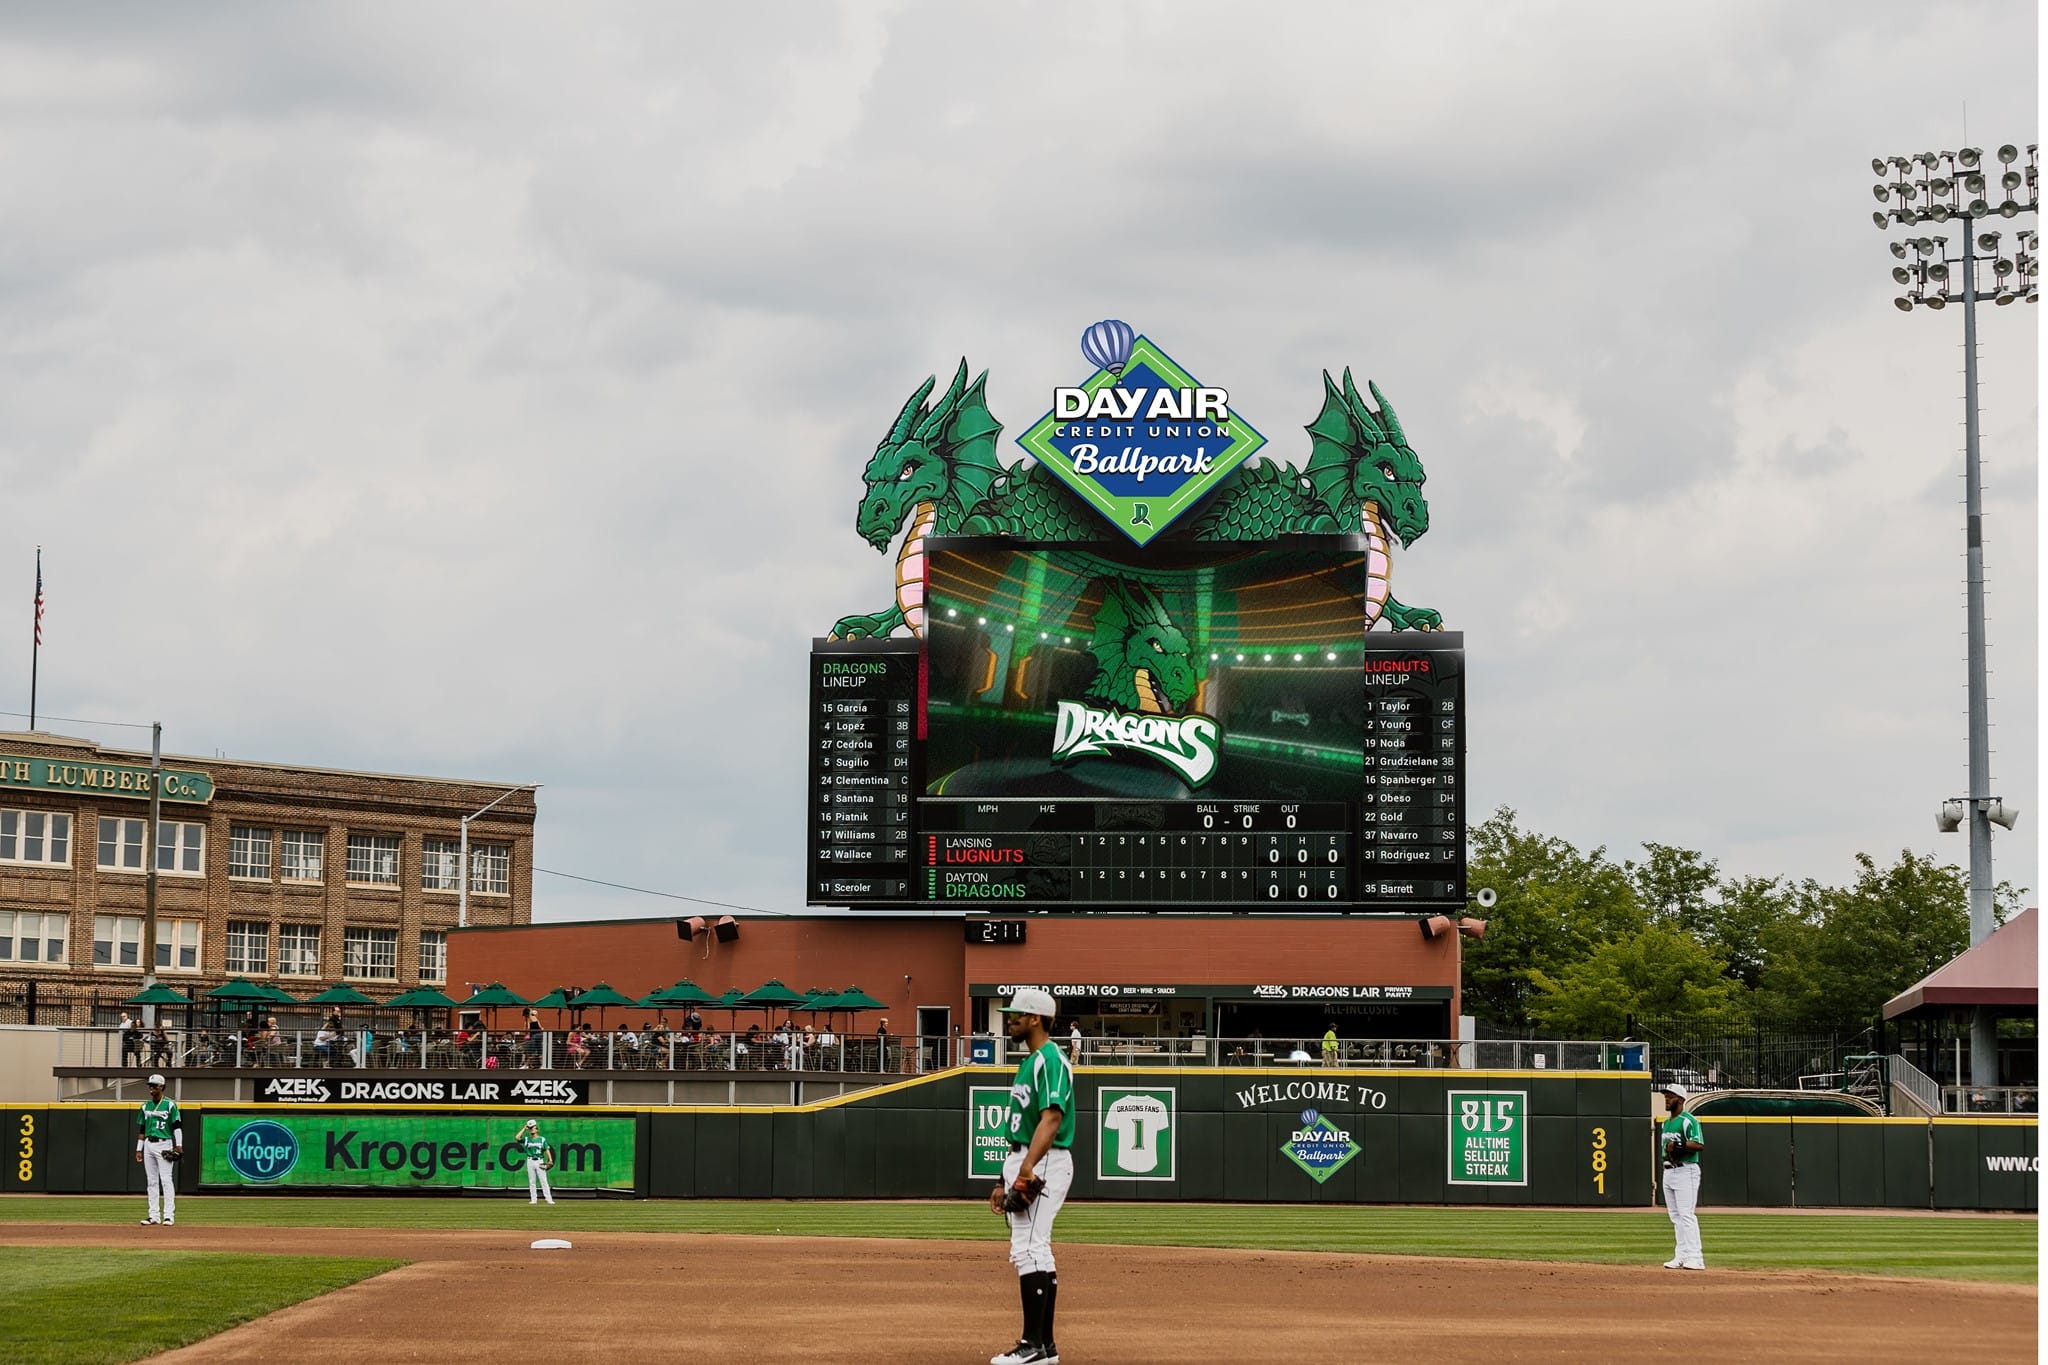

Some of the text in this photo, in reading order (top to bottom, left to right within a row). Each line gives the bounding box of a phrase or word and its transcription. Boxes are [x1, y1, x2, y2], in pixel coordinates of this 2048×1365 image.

[1055, 427, 1230, 437] CREDIT UNION
[1070, 444, 1215, 482] Ballpark
[823, 663, 886, 674] DRAGONS
[1365, 661, 1429, 672] LUGNUTS
[823, 677, 866, 687] LINEUP
[1365, 675, 1409, 684] LINEUP
[822, 704, 909, 713] 15 Garcia SS
[1367, 702, 1454, 713] 1 Taylor 2B
[824, 722, 908, 732] 4 Lopez 3B
[1367, 720, 1454, 730] 2 Young CF
[822, 740, 908, 749] 27 Cedrola CF
[1052, 701, 1219, 784] DRAGONS
[1365, 739, 1454, 747] 19 Noda RF
[824, 758, 908, 769] 5 Sugilio DH
[1380, 757, 1438, 766] Grudzielane
[48, 764, 150, 792] LUMBER
[164, 776, 196, 796] Co.
[822, 776, 908, 785] 24 Clementina C
[1365, 775, 1454, 786] 16 Spanberger 1B
[823, 794, 907, 803] 8 Santana 1B
[1367, 794, 1454, 802] 9 Obeso DH
[978, 805, 1055, 813] MPH H/E
[821, 812, 907, 821] 16 Piatnik LF
[1365, 813, 1454, 821] 22 Gold C
[1204, 816, 1296, 828] 0 0 0
[821, 830, 907, 840] 17 Williams 2B
[1365, 831, 1454, 840] 37 Navarro SS
[946, 839, 992, 848] LANSING
[1080, 837, 1335, 845] 1 2 3 4 5 6 7 8 9 R H E
[820, 849, 907, 859] 22 Wallace RF
[946, 850, 1024, 863] LUGNUTS
[1269, 850, 1337, 862] 0 0 0
[1365, 851, 1454, 861] 31 Rodriguez LF
[946, 873, 988, 882] DAYTON
[1080, 871, 1084, 879] 1
[1100, 871, 1105, 879] 2
[1119, 871, 1125, 879] 3
[1139, 871, 1145, 879] 4
[1160, 871, 1166, 879] 5
[1181, 871, 1186, 879] 6
[1201, 871, 1206, 879] 7
[1221, 871, 1227, 879] 8
[1242, 871, 1247, 879] 9
[820, 883, 905, 892] 11 Sceroler P
[946, 885, 1026, 898] DRAGONS
[1269, 885, 1337, 898] 0 0 0
[1365, 885, 1453, 893] 35 Barrett P
[983, 923, 1019, 938] 2:11
[1054, 985, 1085, 996] GRAB
[1100, 985, 1118, 996] GO
[1253, 985, 1380, 998] AZEK DRAGONS LAIR
[265, 1079, 568, 1100] AZEK DRAGONS LAIR AZEK
[1236, 1082, 1386, 1109] WELCOME TO
[1461, 1100, 1514, 1132] 815
[156, 1121, 166, 1129] 15
[18, 1115, 34, 1182] 338
[1466, 1138, 1509, 1149] ALL-TIME
[237, 1132, 290, 1173] Kroger
[1297, 1150, 1345, 1163] Ballpark
[1464, 1150, 1510, 1162] SELLOUT
[1592, 1128, 1607, 1194] 381
[1466, 1164, 1508, 1175] STREAK
